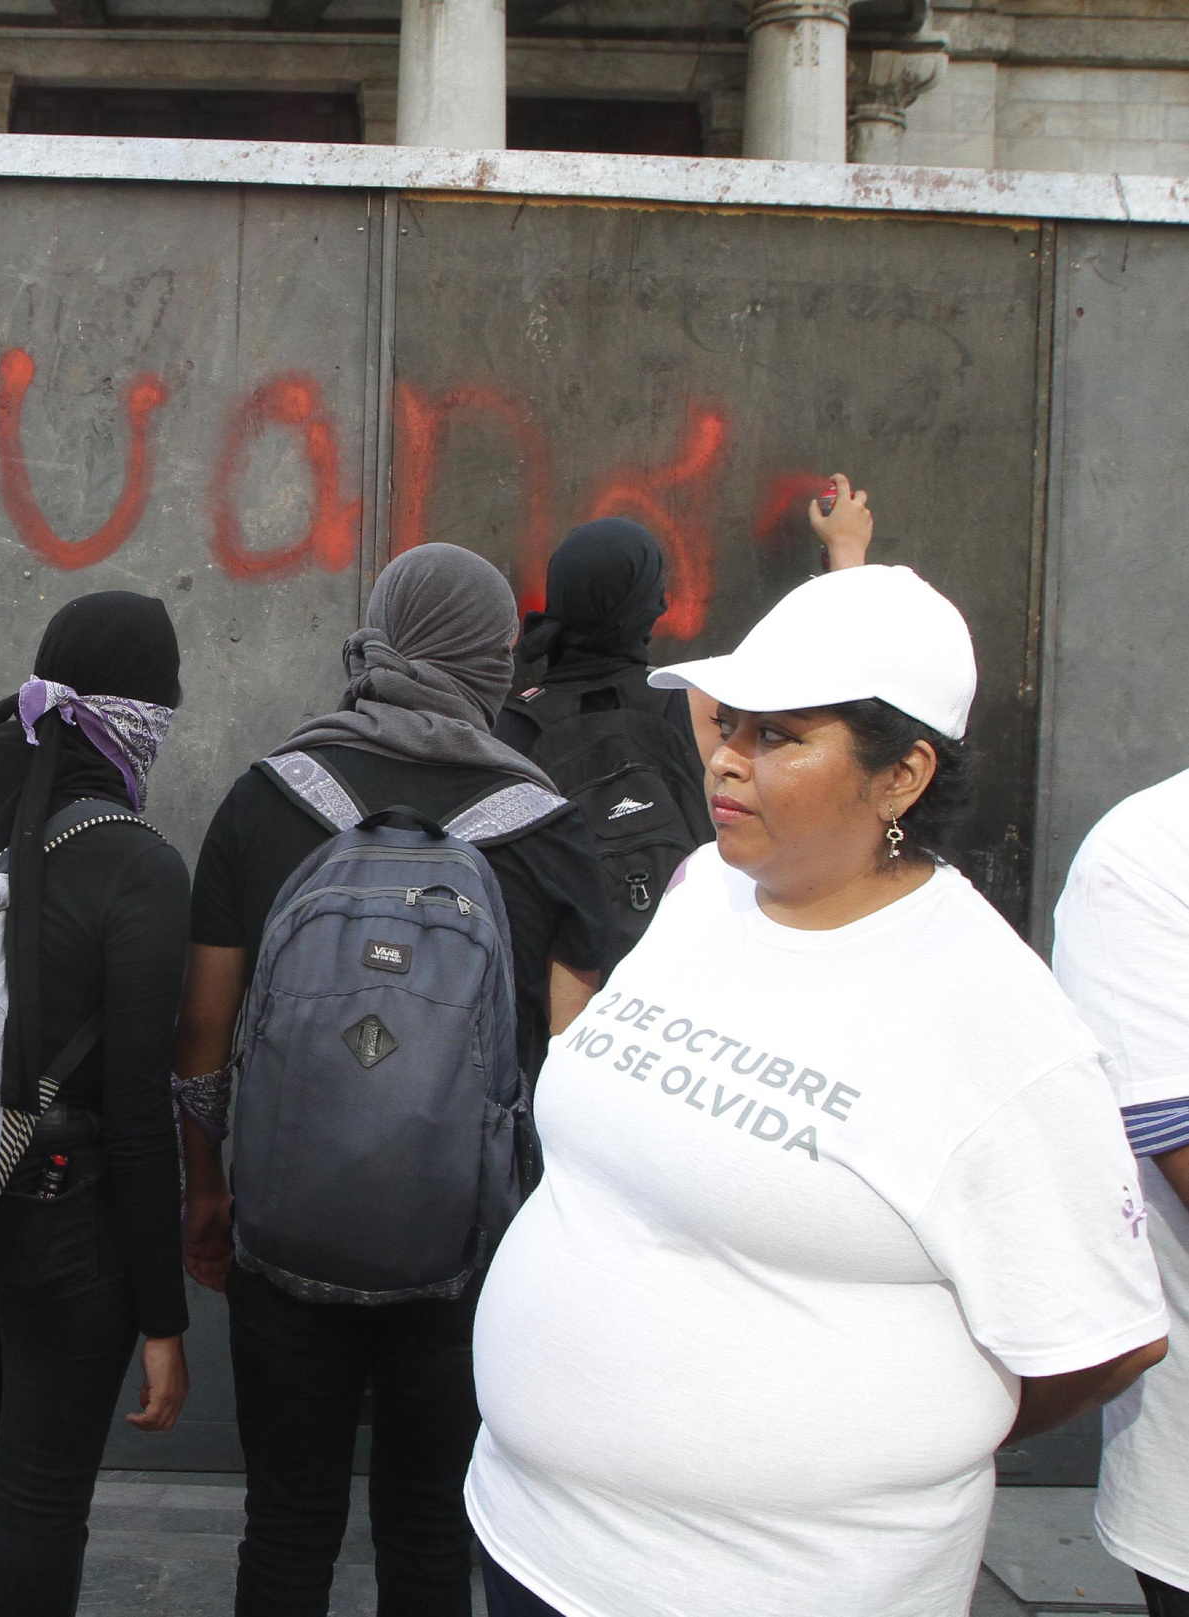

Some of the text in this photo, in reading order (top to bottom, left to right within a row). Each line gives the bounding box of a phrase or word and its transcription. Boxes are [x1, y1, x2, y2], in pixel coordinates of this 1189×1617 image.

[565, 1026, 819, 1163] NO SE OLVIDA
[595, 992, 862, 1122] 2 DE OCTUBRE
